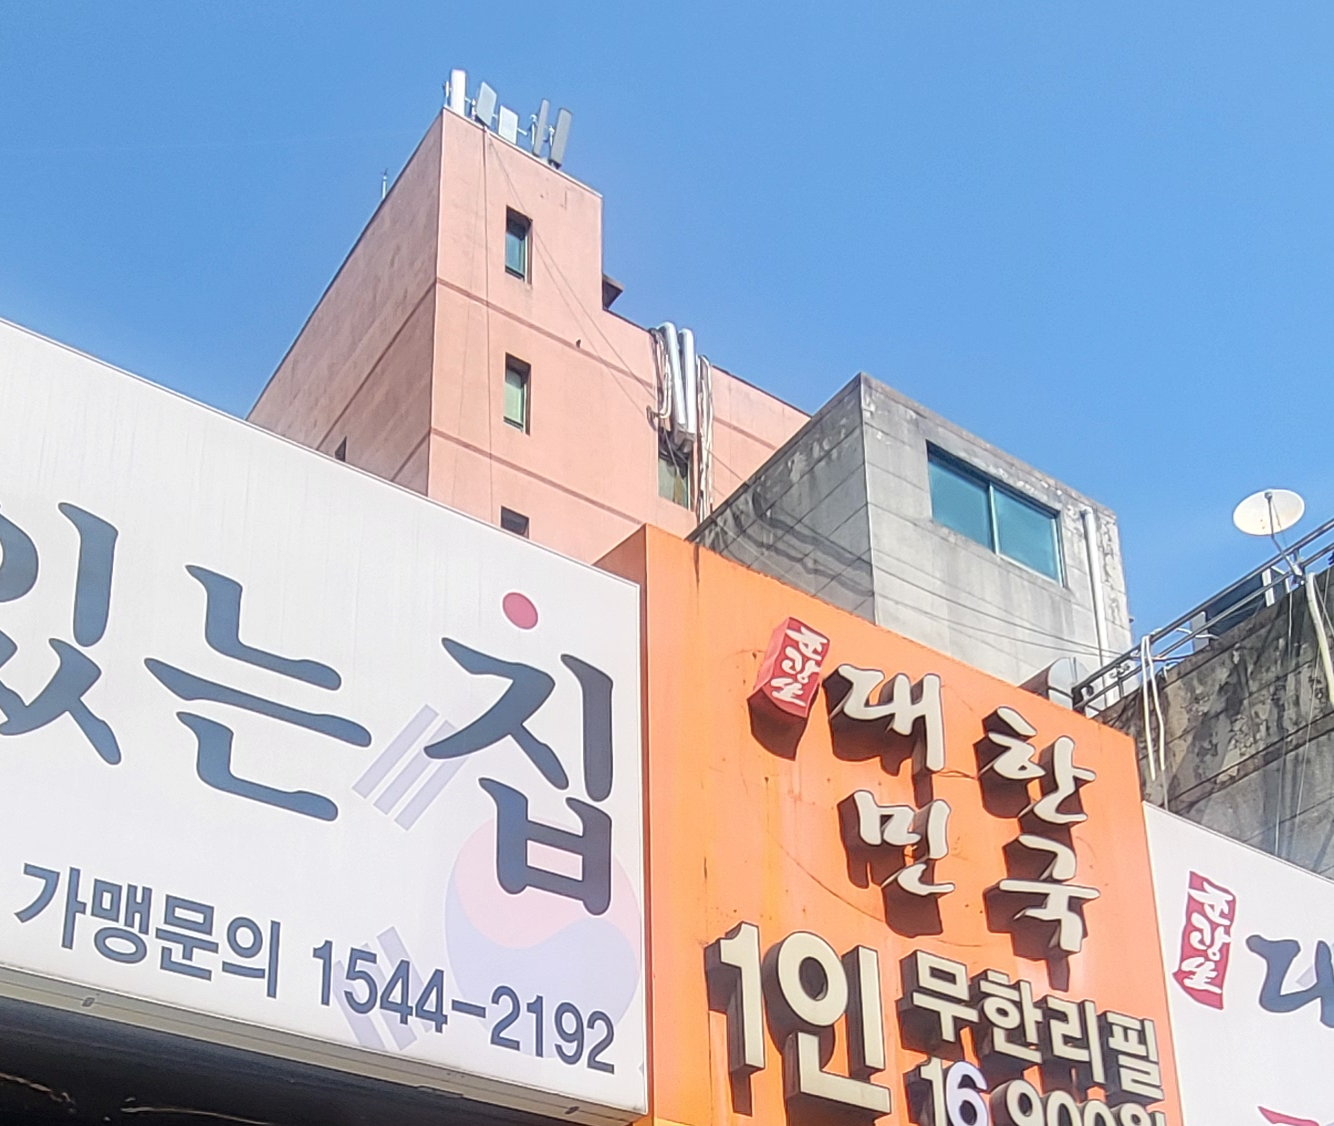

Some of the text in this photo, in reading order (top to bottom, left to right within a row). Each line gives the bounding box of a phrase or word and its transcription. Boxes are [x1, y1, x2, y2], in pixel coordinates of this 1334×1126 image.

[424, 591, 613, 915] 집
[14, 860, 281, 998] 가맹문의
[311, 939, 616, 1074] 1544-2192
[719, 921, 1166, 1115] 1인 무한리필
